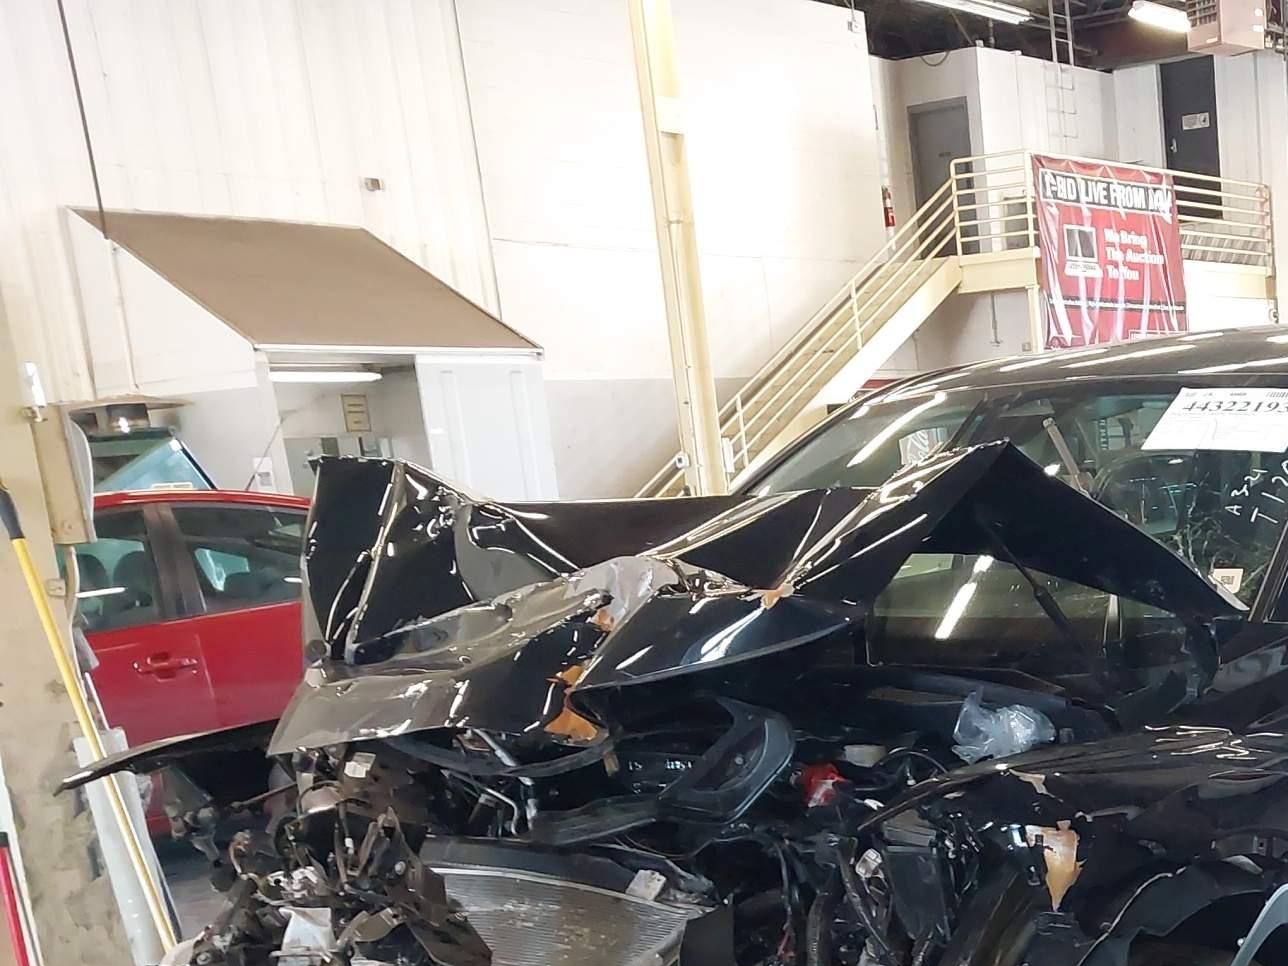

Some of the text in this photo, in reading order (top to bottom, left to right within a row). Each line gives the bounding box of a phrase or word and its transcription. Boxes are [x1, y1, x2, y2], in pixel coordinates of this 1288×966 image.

[1080, 179, 1108, 203] LIVE
[1109, 183, 1146, 208] FROM
[1120, 230, 1147, 250] Bring
[1126, 249, 1164, 264] Auction
[1106, 265, 1119, 279] To
